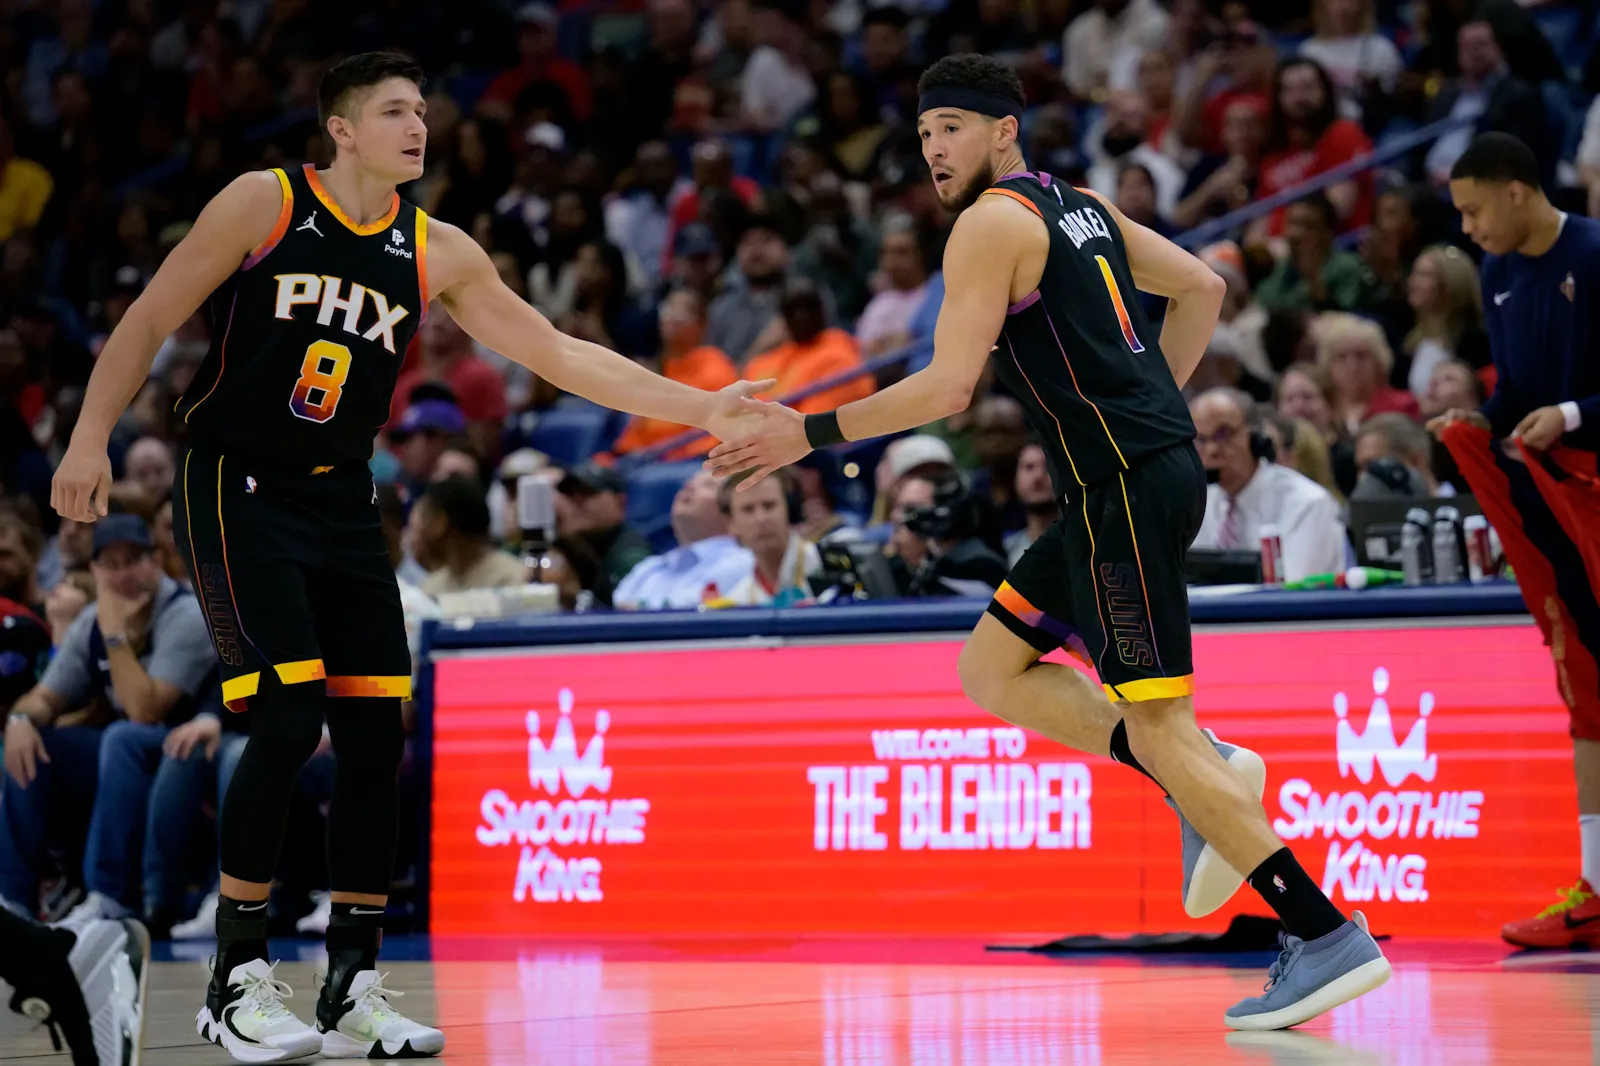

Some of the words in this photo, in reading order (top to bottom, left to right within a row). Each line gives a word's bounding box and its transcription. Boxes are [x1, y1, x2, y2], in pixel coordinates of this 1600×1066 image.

[384, 243, 412, 259] PayPal
[273, 273, 409, 354] PHX
[1094, 255, 1145, 353] 1
[289, 339, 352, 423] 8
[1100, 562, 1153, 666] SUNS
[871, 729, 991, 760] WELCOME
[993, 727, 1026, 758] TO
[806, 766, 889, 851] THE
[900, 763, 1092, 849] BLENDER
[1273, 778, 1484, 840] SMOOTHIE
